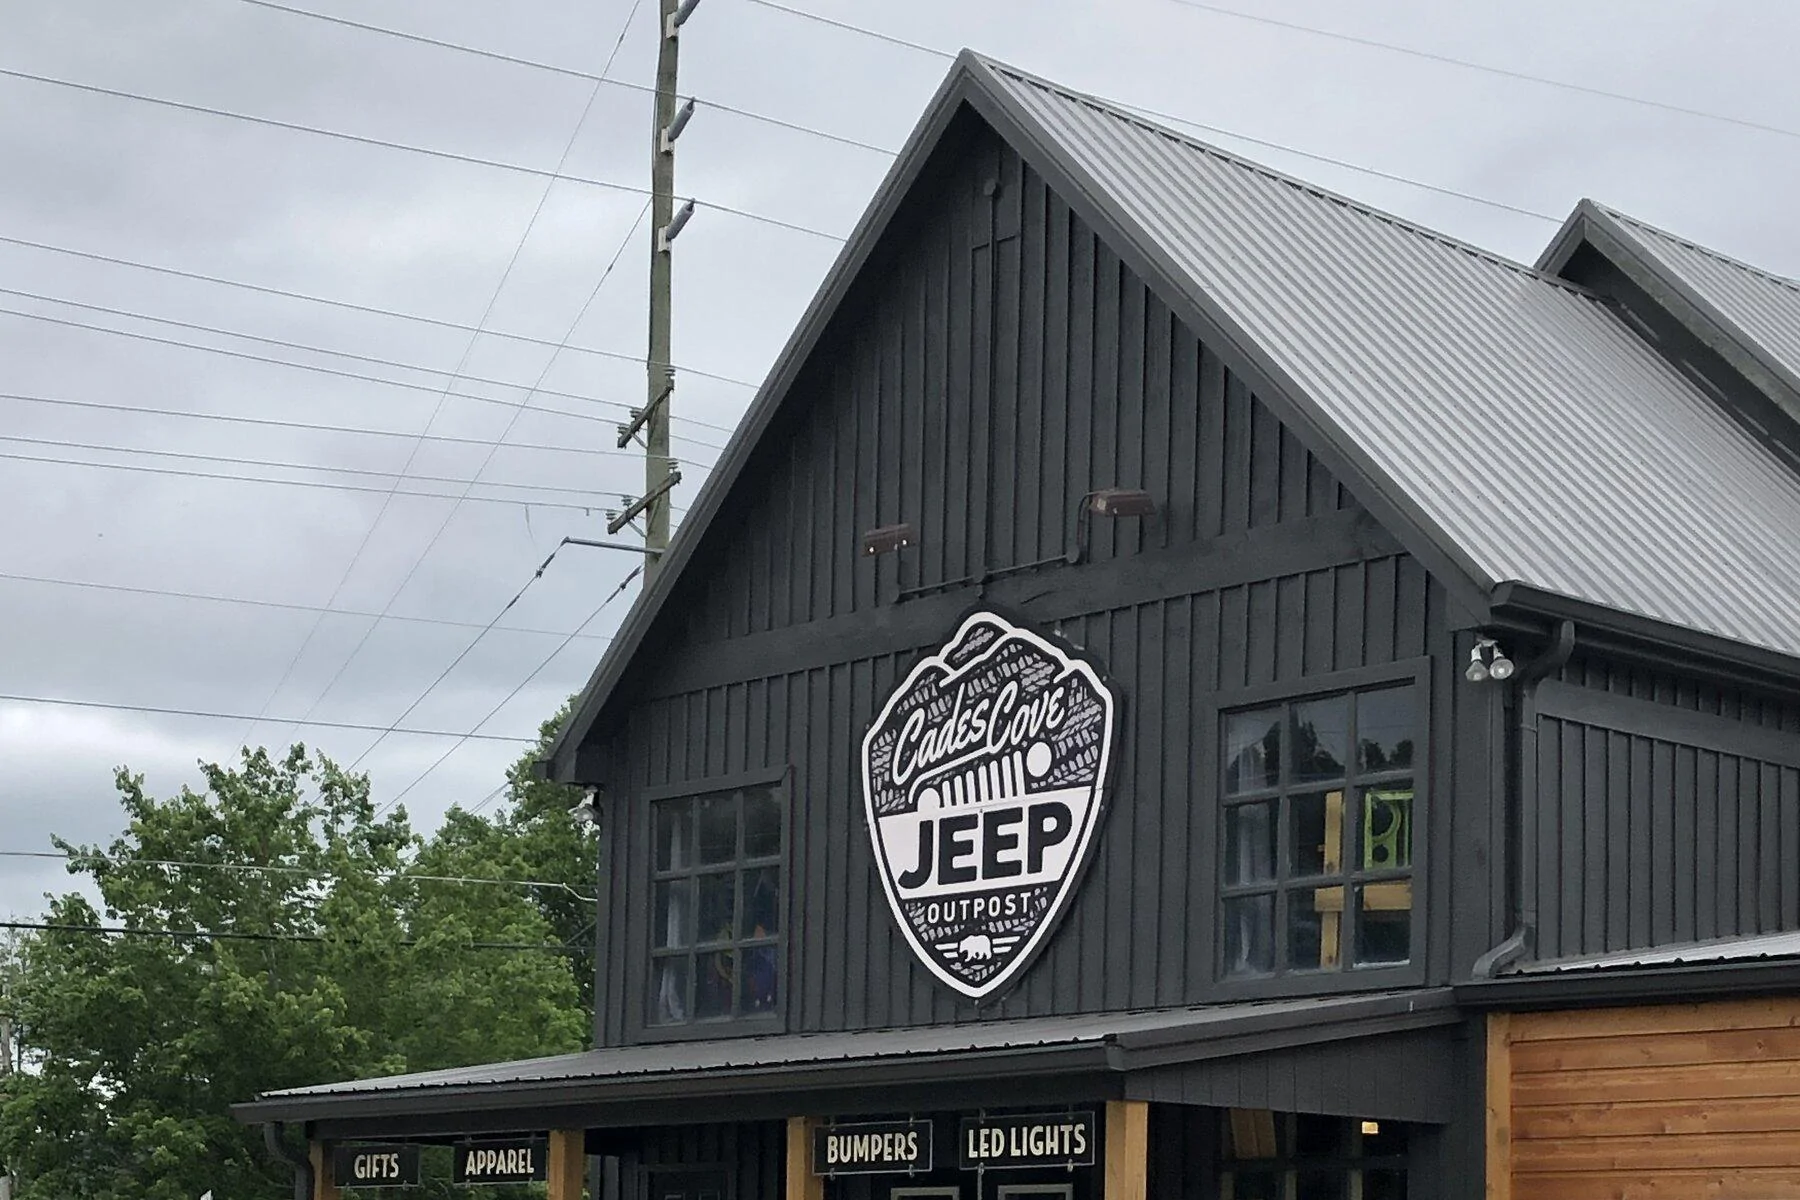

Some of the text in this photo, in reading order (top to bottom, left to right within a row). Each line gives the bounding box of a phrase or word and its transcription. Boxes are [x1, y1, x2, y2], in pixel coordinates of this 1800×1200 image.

[898, 802, 1073, 889] JEEP
[927, 892, 1031, 924] OUTPOST
[826, 1131, 918, 1163] BUMPERS
[968, 1123, 1086, 1158] LED LIGHTS
[354, 1152, 399, 1179] GIFTS
[465, 1148, 535, 1176] APPAREL
